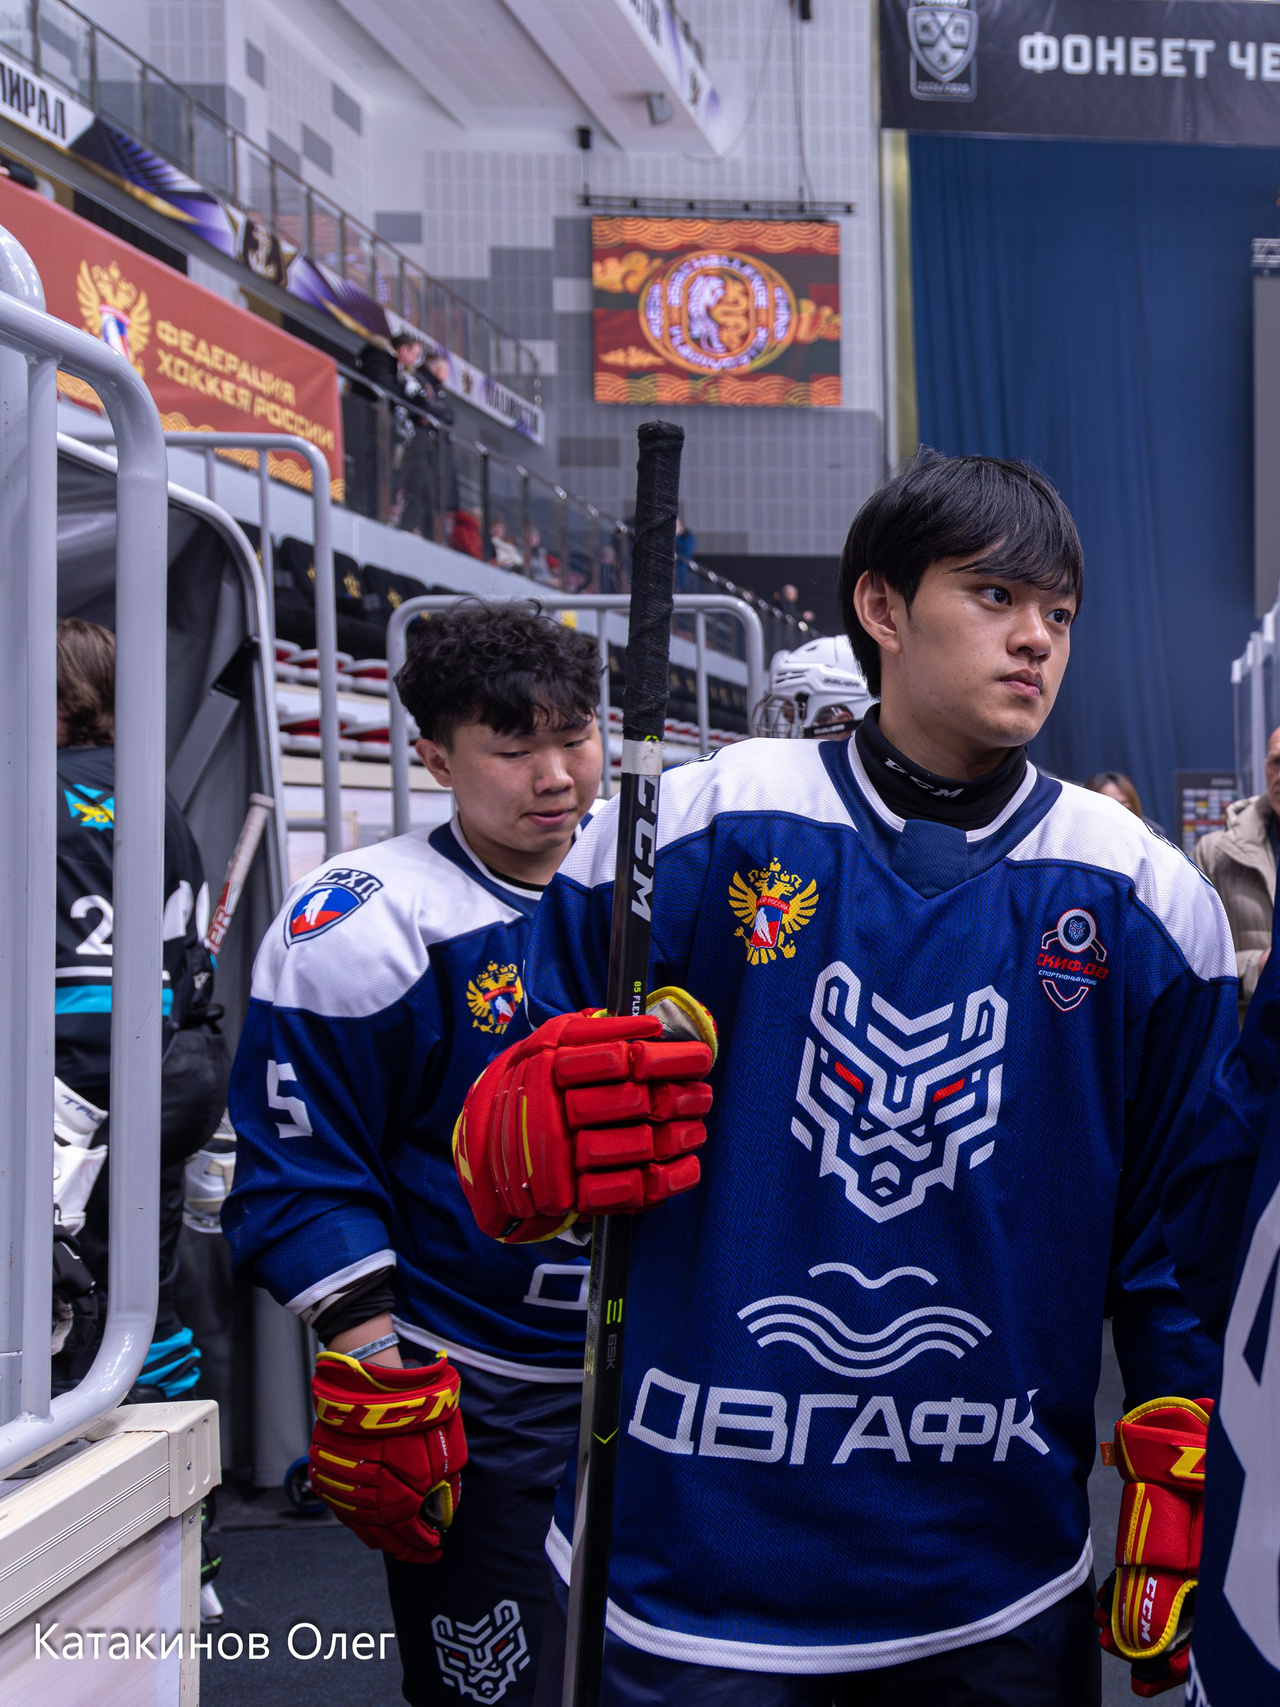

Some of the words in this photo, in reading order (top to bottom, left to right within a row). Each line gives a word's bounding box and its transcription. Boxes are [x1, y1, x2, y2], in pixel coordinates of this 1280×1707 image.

[1018, 31, 1216, 80] ФОНБЕТ
[0, 62, 66, 140] ИРАЛ
[156, 319, 296, 407] ФЕДЕРАЦИЯ
[157, 348, 252, 414] ХОККЕЯ
[253, 394, 336, 450] РОССИИ
[822, 677, 860, 688] BAUER
[813, 723, 846, 736] BAUER
[884, 757, 964, 798] CCM
[631, 775, 661, 923] CCM
[631, 995, 641, 1018] FLEX
[633, 980, 642, 993] 85
[266, 1060, 313, 1139] 5
[316, 1377, 461, 1430] CCM
[627, 1367, 1051, 1465] ДВГАФК
[1141, 1576, 1158, 1643] CCM
